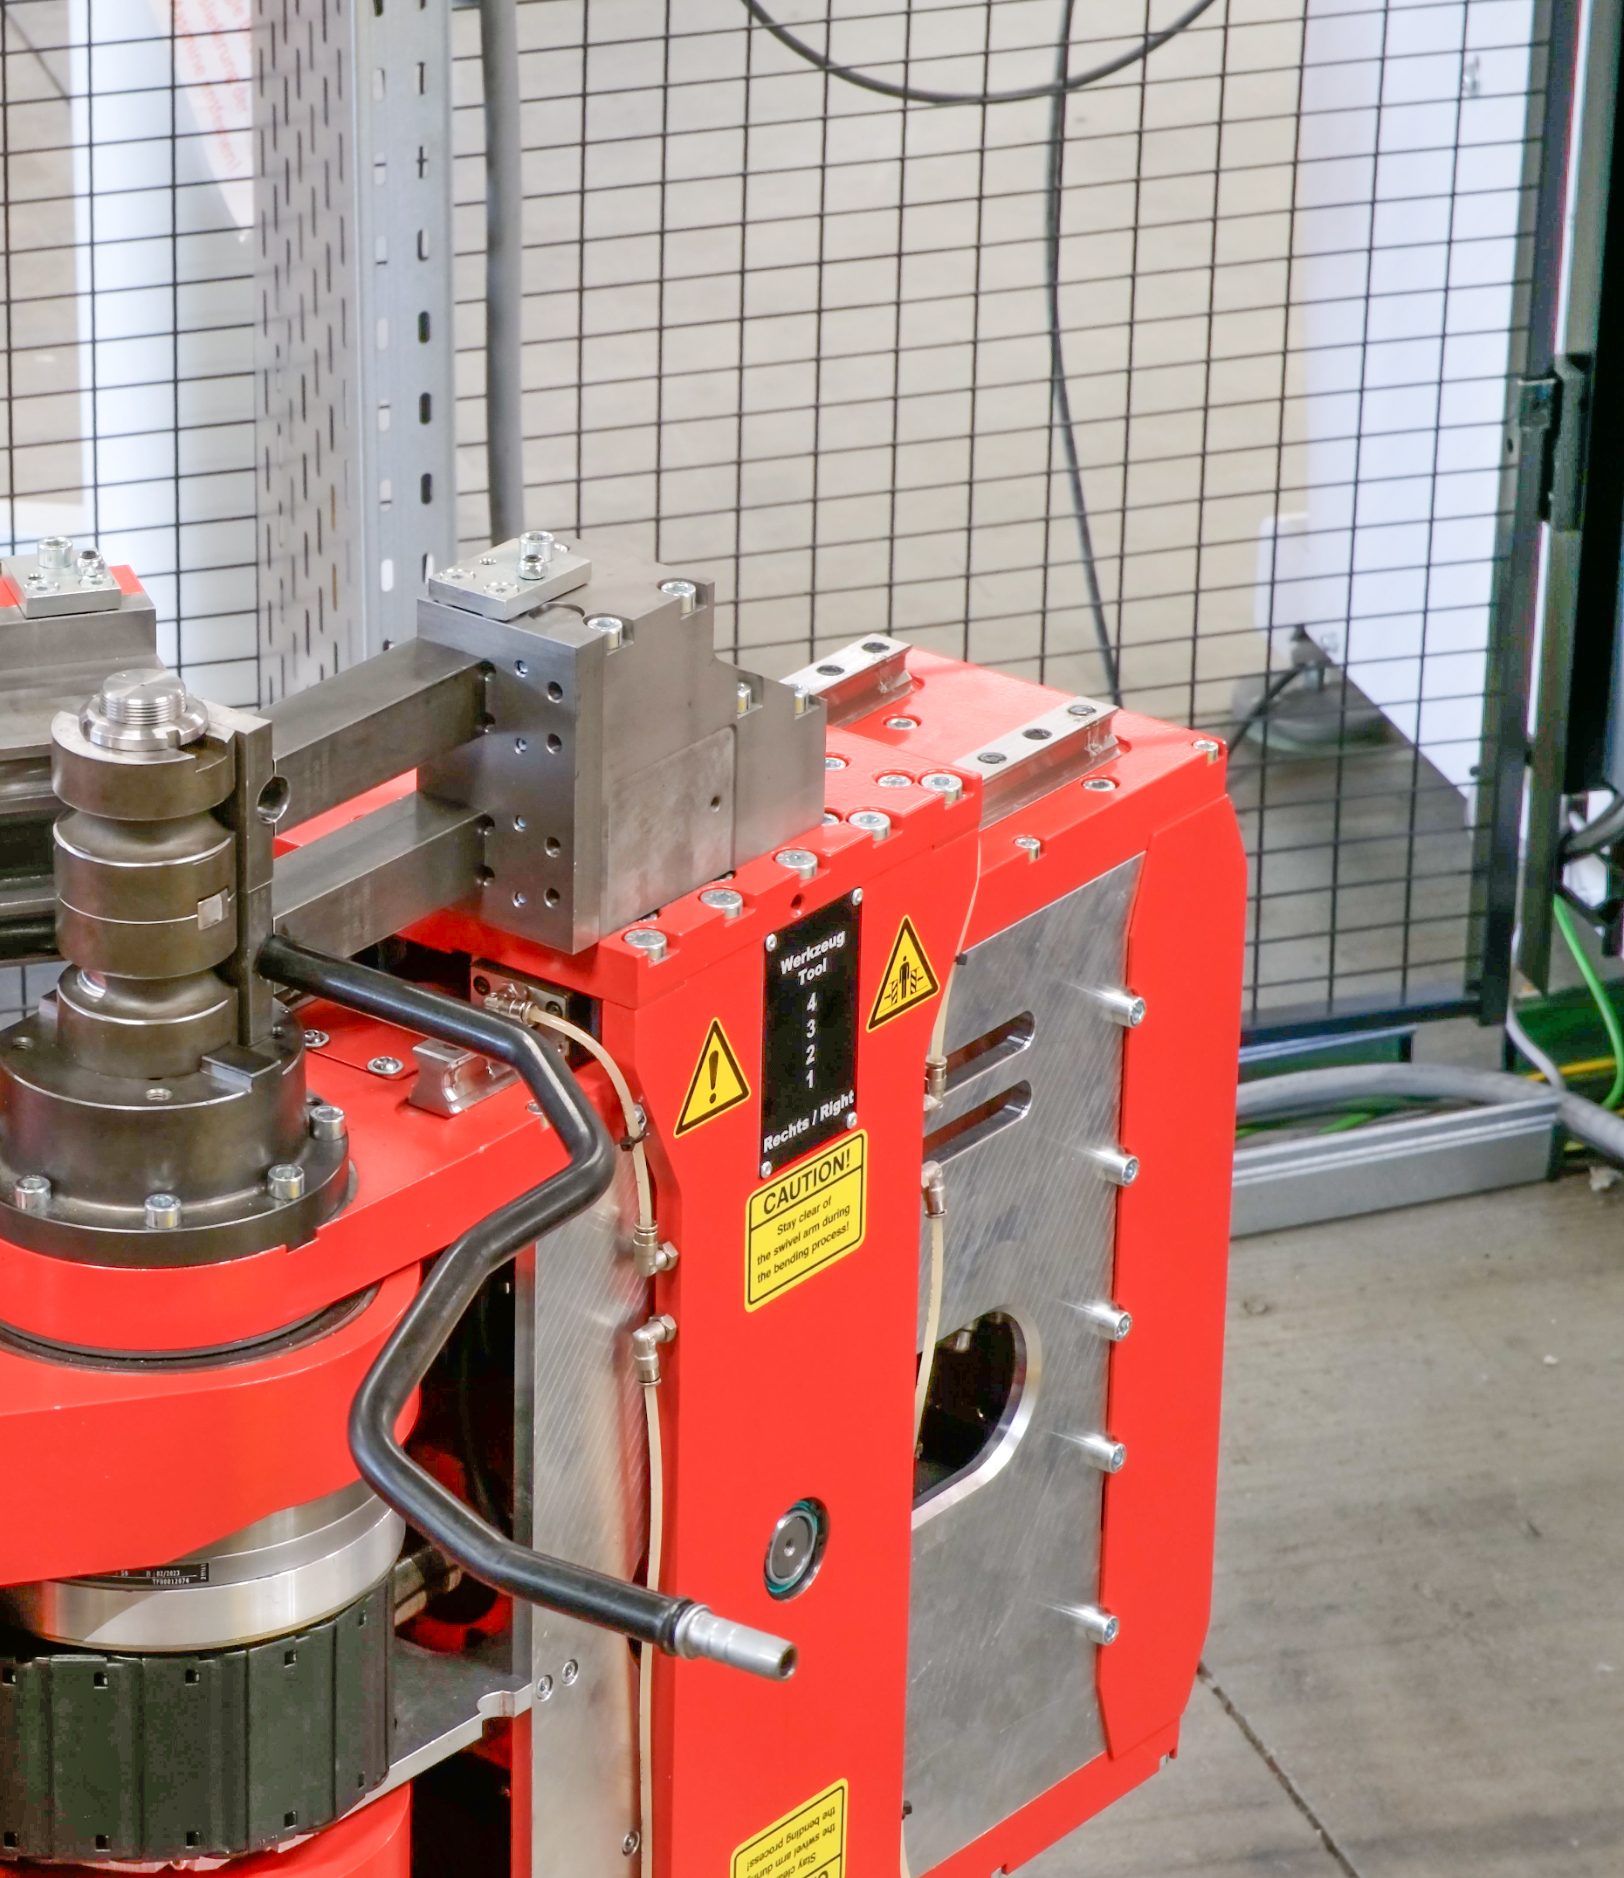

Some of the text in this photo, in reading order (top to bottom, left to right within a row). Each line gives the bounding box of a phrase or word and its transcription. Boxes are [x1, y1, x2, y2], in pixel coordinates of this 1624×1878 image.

[780, 930, 846, 975] Werkzeug
[797, 957, 827, 986] Tool
[806, 991, 817, 1011] 4
[806, 1019, 816, 1038] 3
[805, 1044, 816, 1065] 2
[805, 1069, 814, 1088] 1
[763, 1089, 855, 1153] Rechts / Right
[763, 1148, 851, 1215] CAUTION!
[777, 1195, 832, 1236] Stay clear of
[757, 1205, 851, 1265] the swivel arm during
[757, 1221, 850, 1283] the bending process!
[746, 1806, 836, 1872] the bending process!
[822, 1823, 836, 1836] the
[775, 1851, 792, 1867] arm
[794, 1833, 820, 1858] swivel
[798, 1852, 816, 1870] Stay
